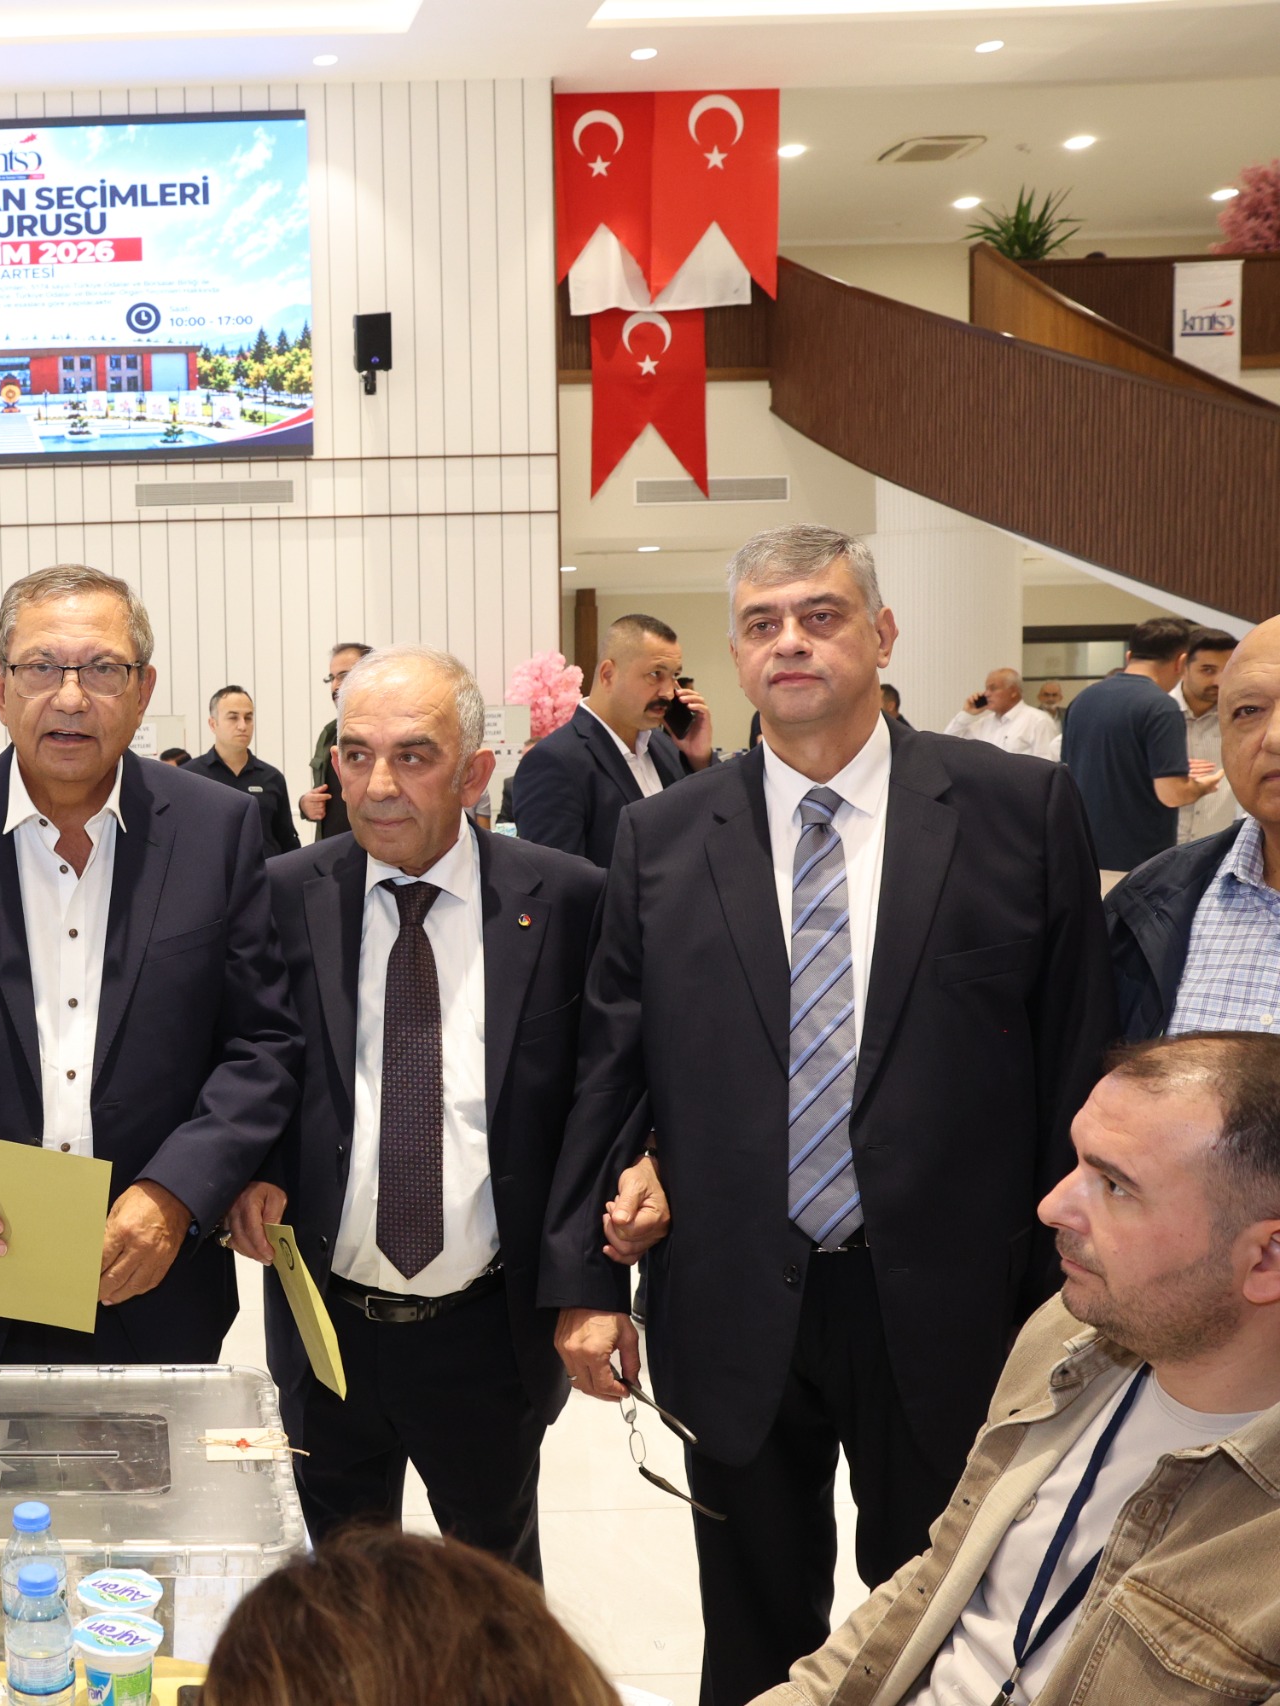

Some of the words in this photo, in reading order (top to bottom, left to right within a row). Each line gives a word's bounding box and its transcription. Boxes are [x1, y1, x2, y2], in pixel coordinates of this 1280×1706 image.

[35, 175, 210, 212] SEÇİMLERİ
[38, 240, 116, 265] 2026
[169, 316, 206, 328] 10:00
[217, 314, 254, 327] 17:00
[91, 1579, 152, 1602] Ayran
[86, 1621, 152, 1646] Ayran
